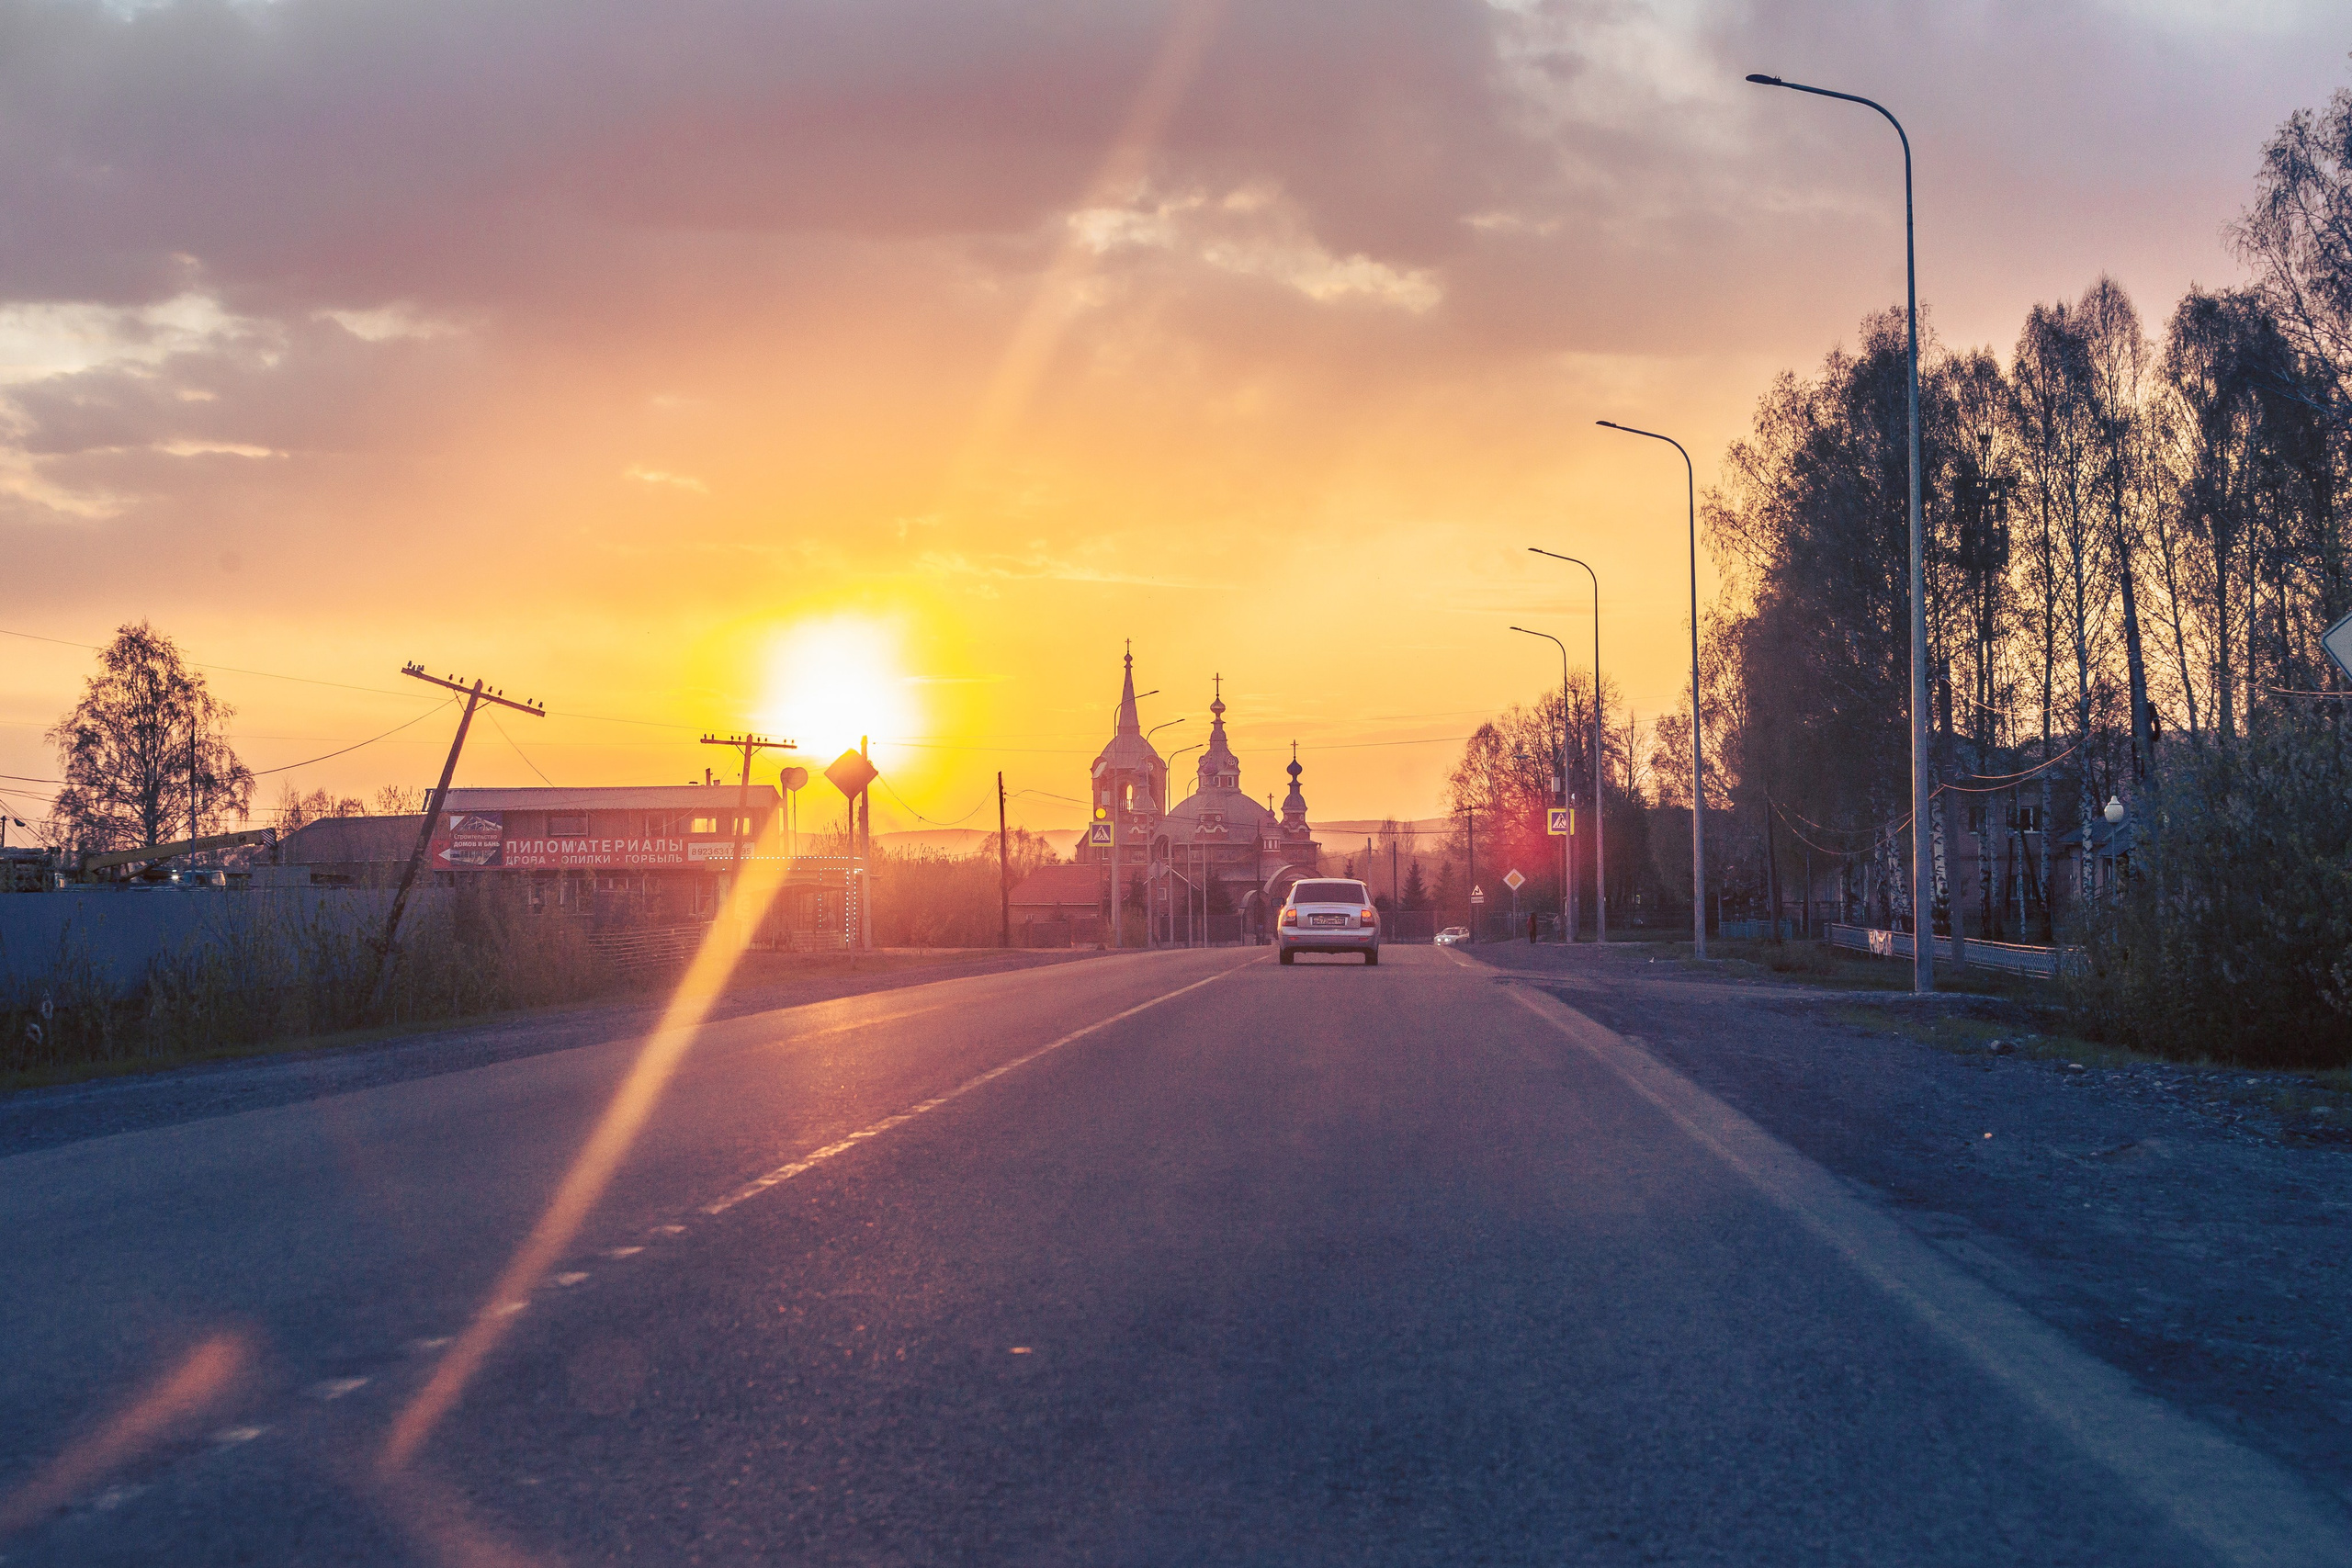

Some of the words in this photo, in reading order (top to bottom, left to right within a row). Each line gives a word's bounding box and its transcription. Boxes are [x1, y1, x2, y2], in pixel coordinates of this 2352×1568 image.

[506, 839, 684, 853] ПИЛОМАТЕРИАЛЫ
[691, 847, 752, 856] 8923634795
[505, 855, 547, 865] ДРОВА
[561, 854, 611, 864] ОПИЛКИ
[625, 853, 683, 863] ГОРБЫЛЬ
